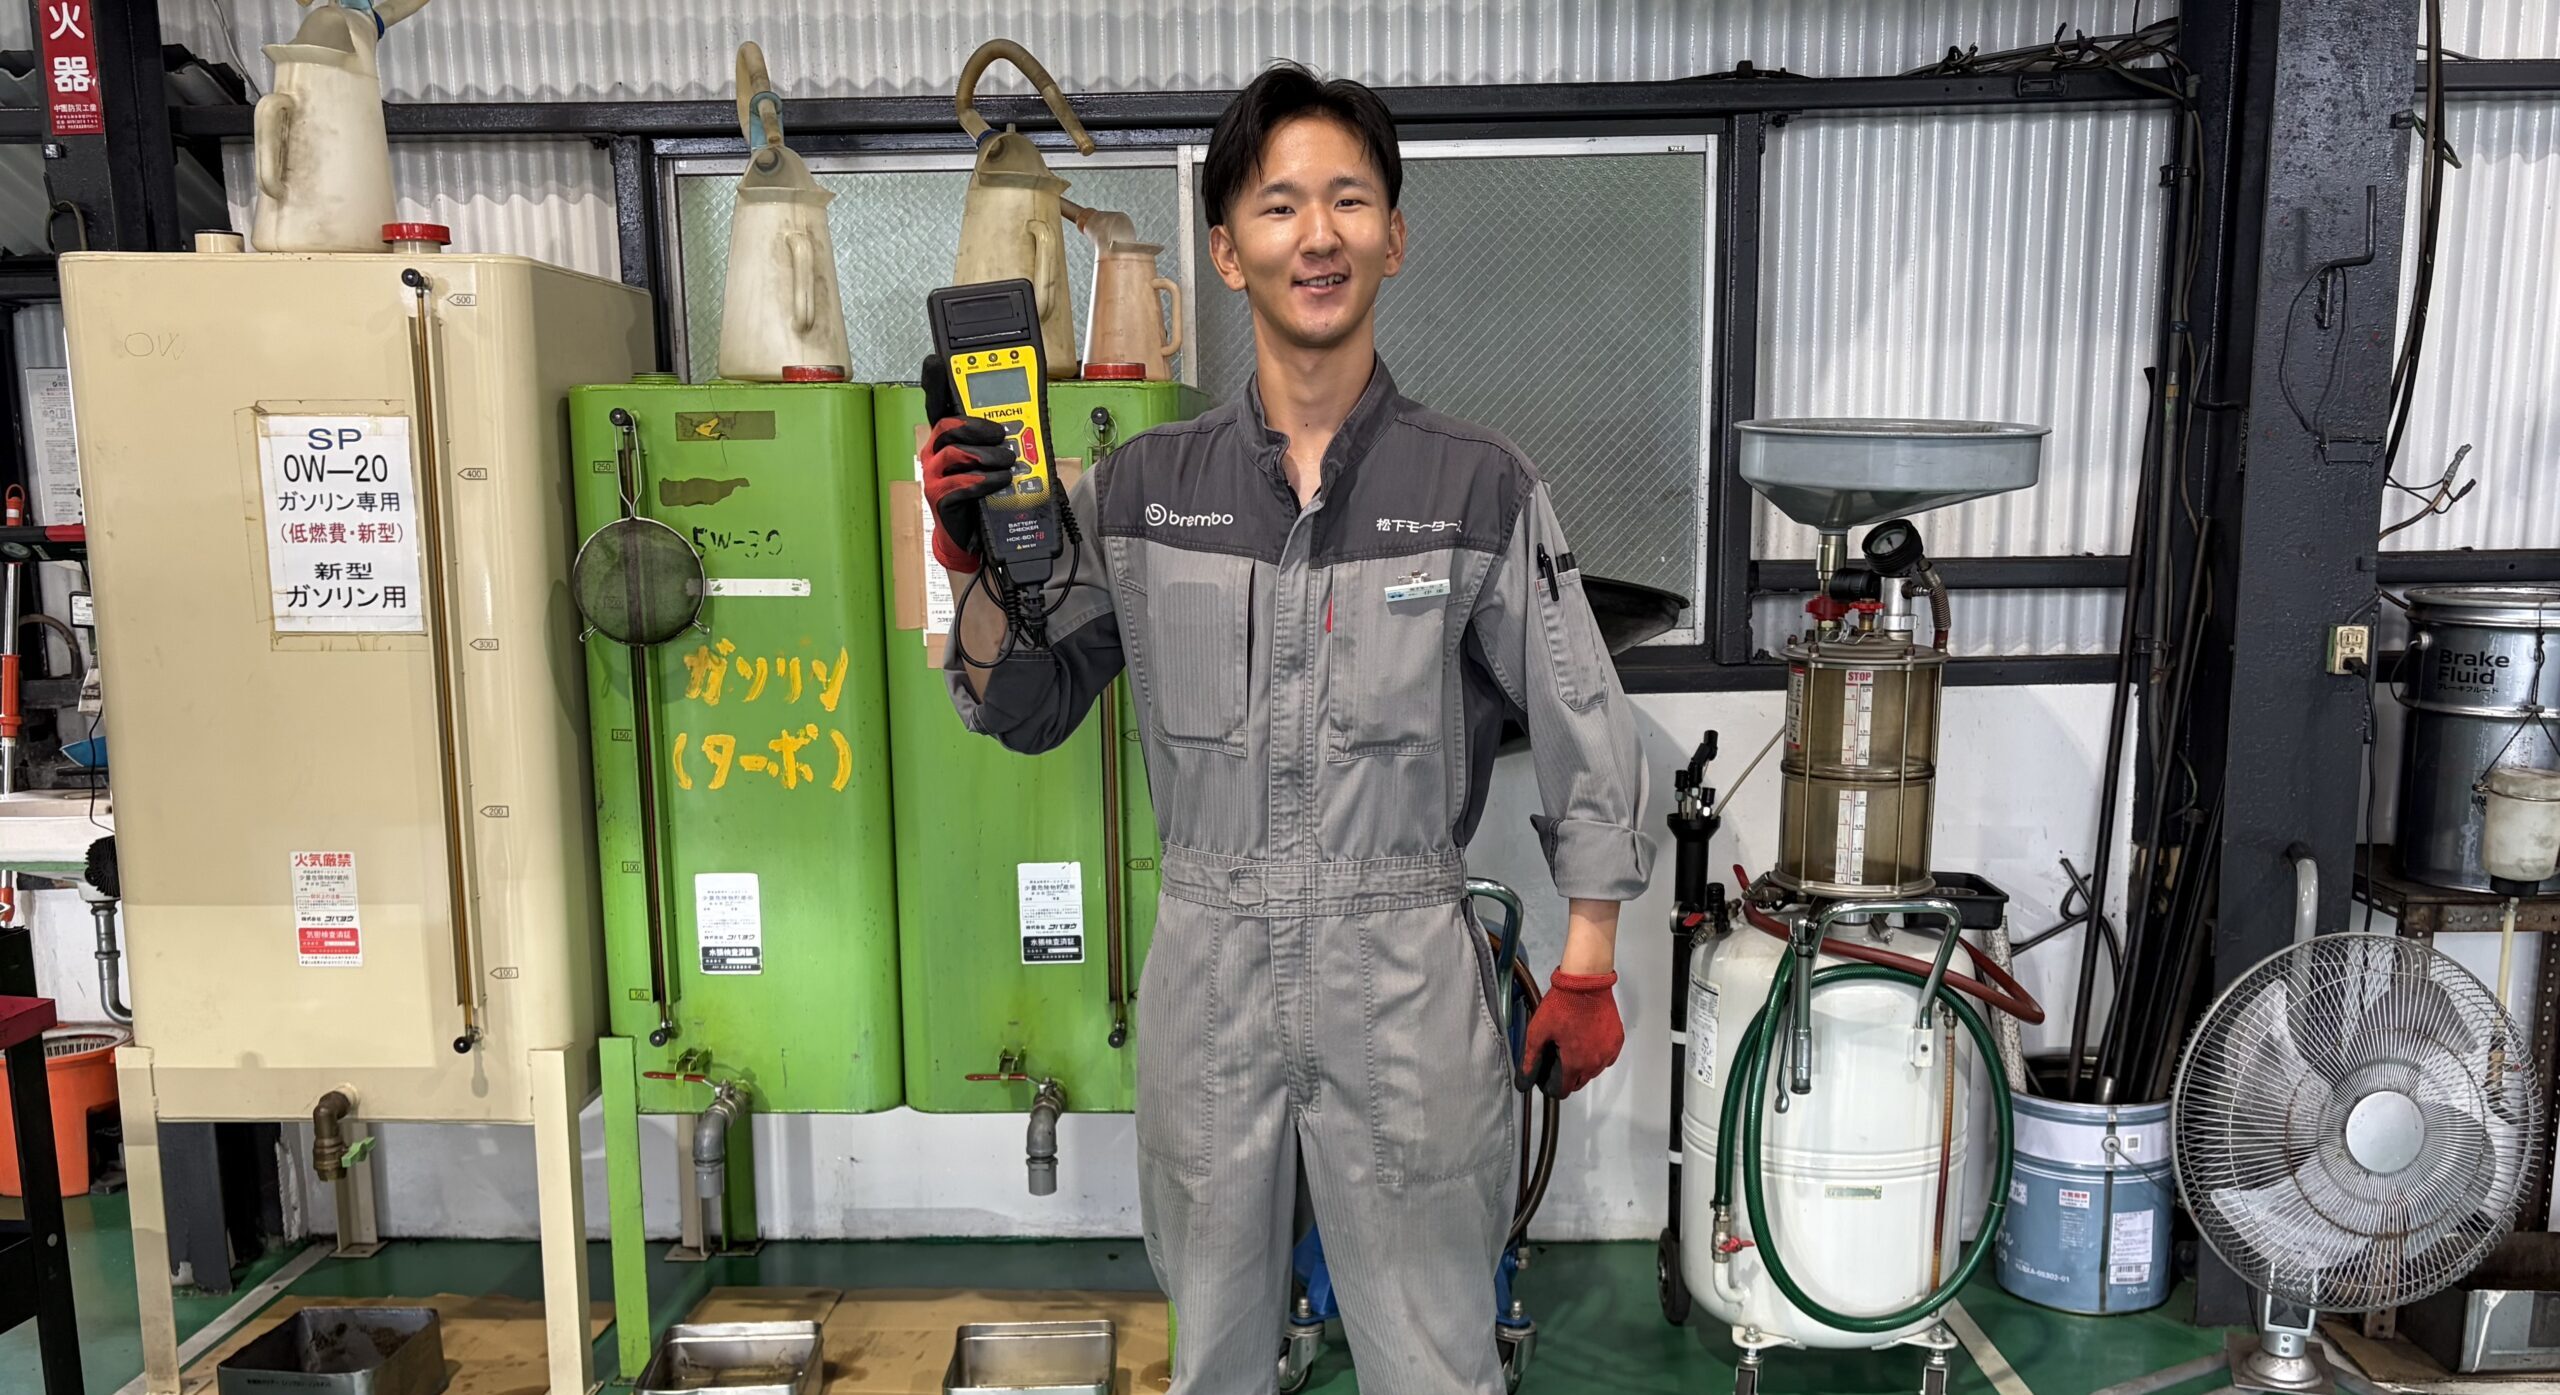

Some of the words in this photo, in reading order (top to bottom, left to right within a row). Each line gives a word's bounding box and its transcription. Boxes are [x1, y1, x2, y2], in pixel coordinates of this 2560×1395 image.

[983, 407, 1023, 420] HITACHI
[308, 428, 362, 450] SP
[278, 491, 401, 512] ガソリン専用
[1008, 520, 1038, 529] BATTERY
[1169, 510, 1234, 527] brembo
[1009, 525, 1039, 533] CHECKER
[314, 562, 374, 581] 新型
[287, 584, 407, 608] ガソリン用
[2439, 650, 2510, 668] Brake
[683, 638, 849, 712] ガソリン
[1848, 671, 1872, 681] STOP
[2437, 667, 2495, 685] Fluid
[294, 853, 352, 868] 火気厳禁
